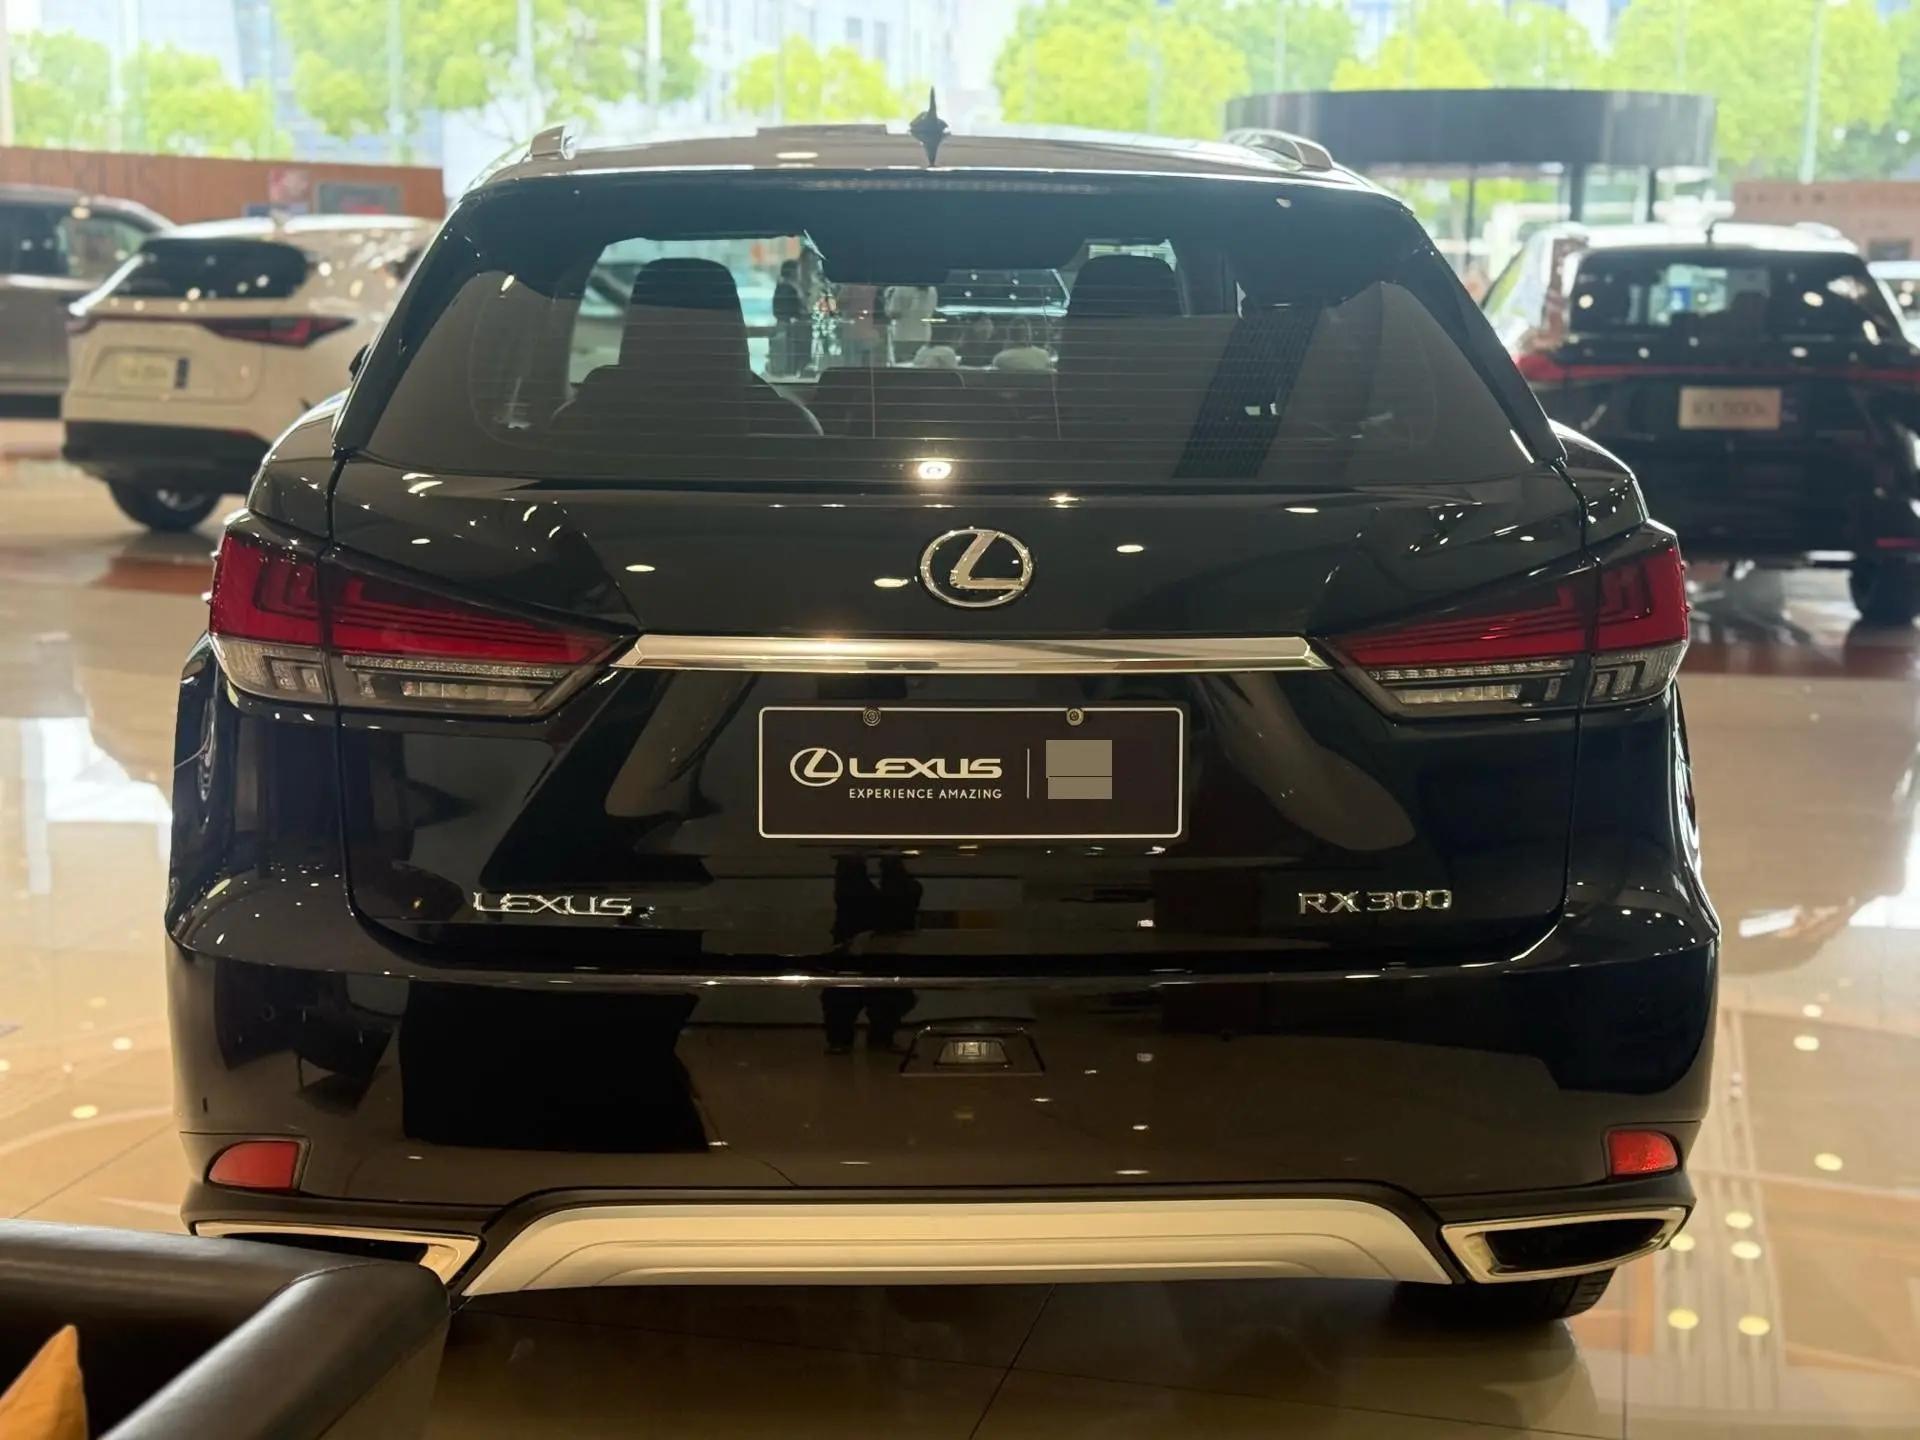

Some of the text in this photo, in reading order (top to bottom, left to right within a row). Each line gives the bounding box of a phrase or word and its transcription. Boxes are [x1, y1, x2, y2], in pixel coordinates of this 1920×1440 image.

[849, 758, 1003, 779] LEXUS
[849, 788, 1003, 799] EXPERIENCE AMAZING
[473, 891, 632, 916] LEXUS
[1298, 889, 1453, 915] RX 300
